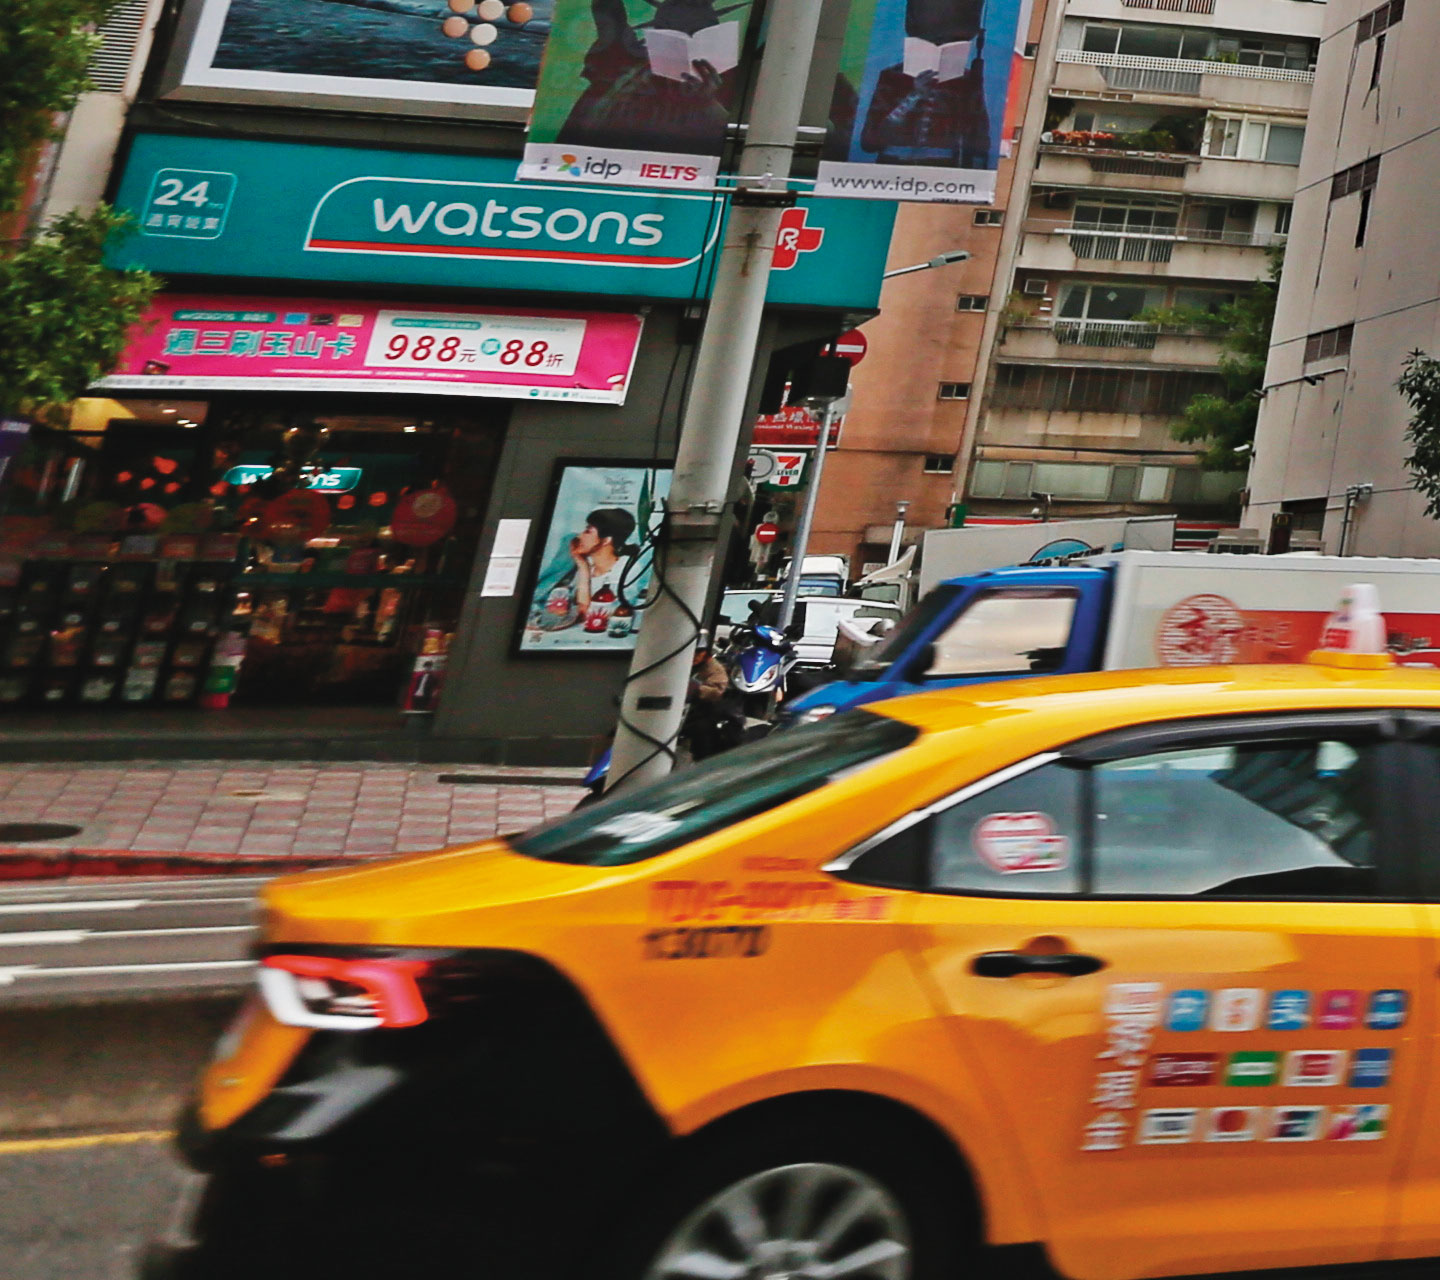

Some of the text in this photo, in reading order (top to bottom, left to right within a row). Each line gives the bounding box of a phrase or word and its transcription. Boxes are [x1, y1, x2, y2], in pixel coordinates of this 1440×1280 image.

[584, 156, 622, 181] idp
[639, 162, 698, 184] IELTS
[153, 178, 210, 208] 24
[830, 171, 976, 196] www.idp.com
[372, 193, 665, 248] watsons
